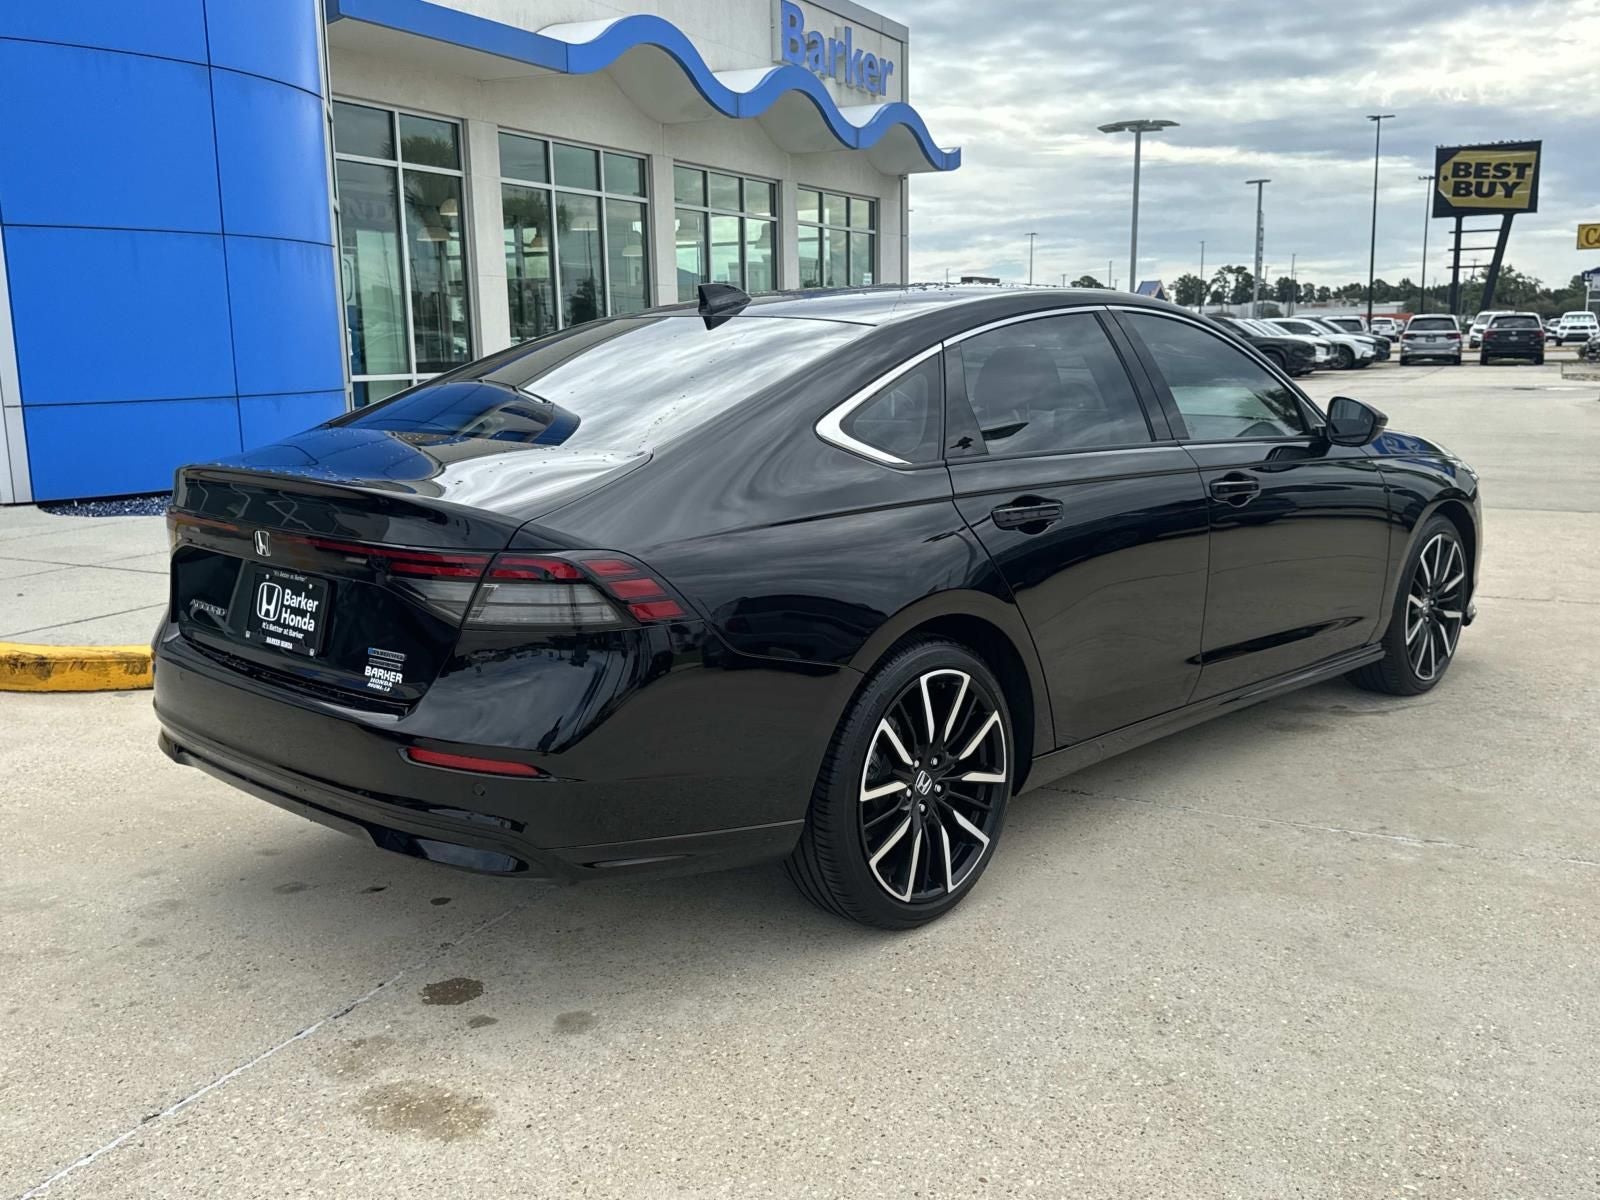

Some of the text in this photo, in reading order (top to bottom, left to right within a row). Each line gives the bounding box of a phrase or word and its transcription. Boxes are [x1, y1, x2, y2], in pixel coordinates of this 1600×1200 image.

[781, 0, 894, 96] Barker
[1451, 161, 1532, 180] BEST
[1452, 180, 1522, 198] BUY
[284, 588, 319, 612] Barker
[280, 607, 315, 632] Honda
[364, 665, 403, 684] BARKER
